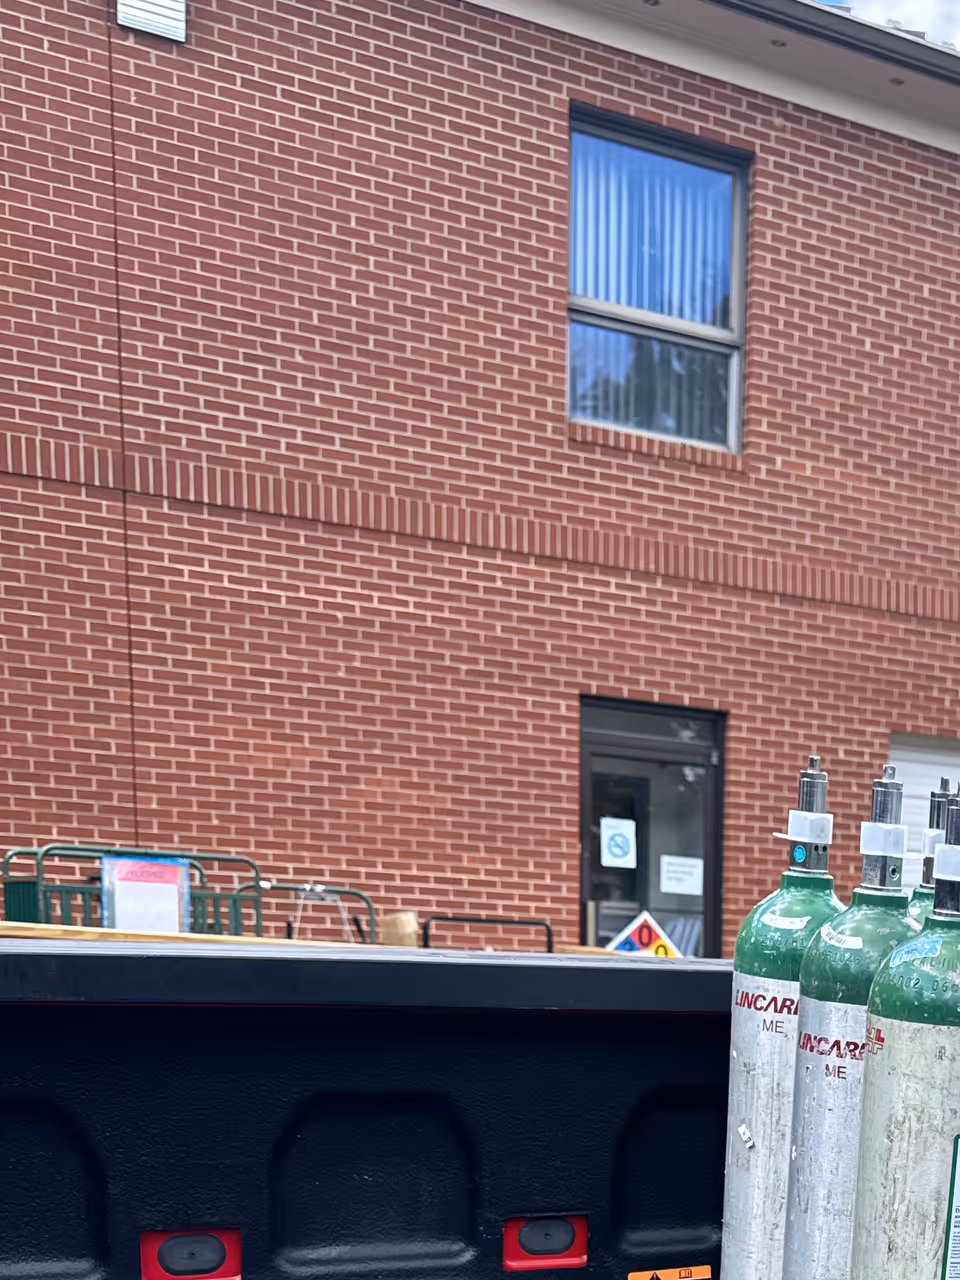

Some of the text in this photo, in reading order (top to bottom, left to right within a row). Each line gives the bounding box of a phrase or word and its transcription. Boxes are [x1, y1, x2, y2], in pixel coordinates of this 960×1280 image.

[638, 925, 652, 947] 0
[762, 1018, 785, 1034] ME
[825, 1063, 847, 1080] ME
